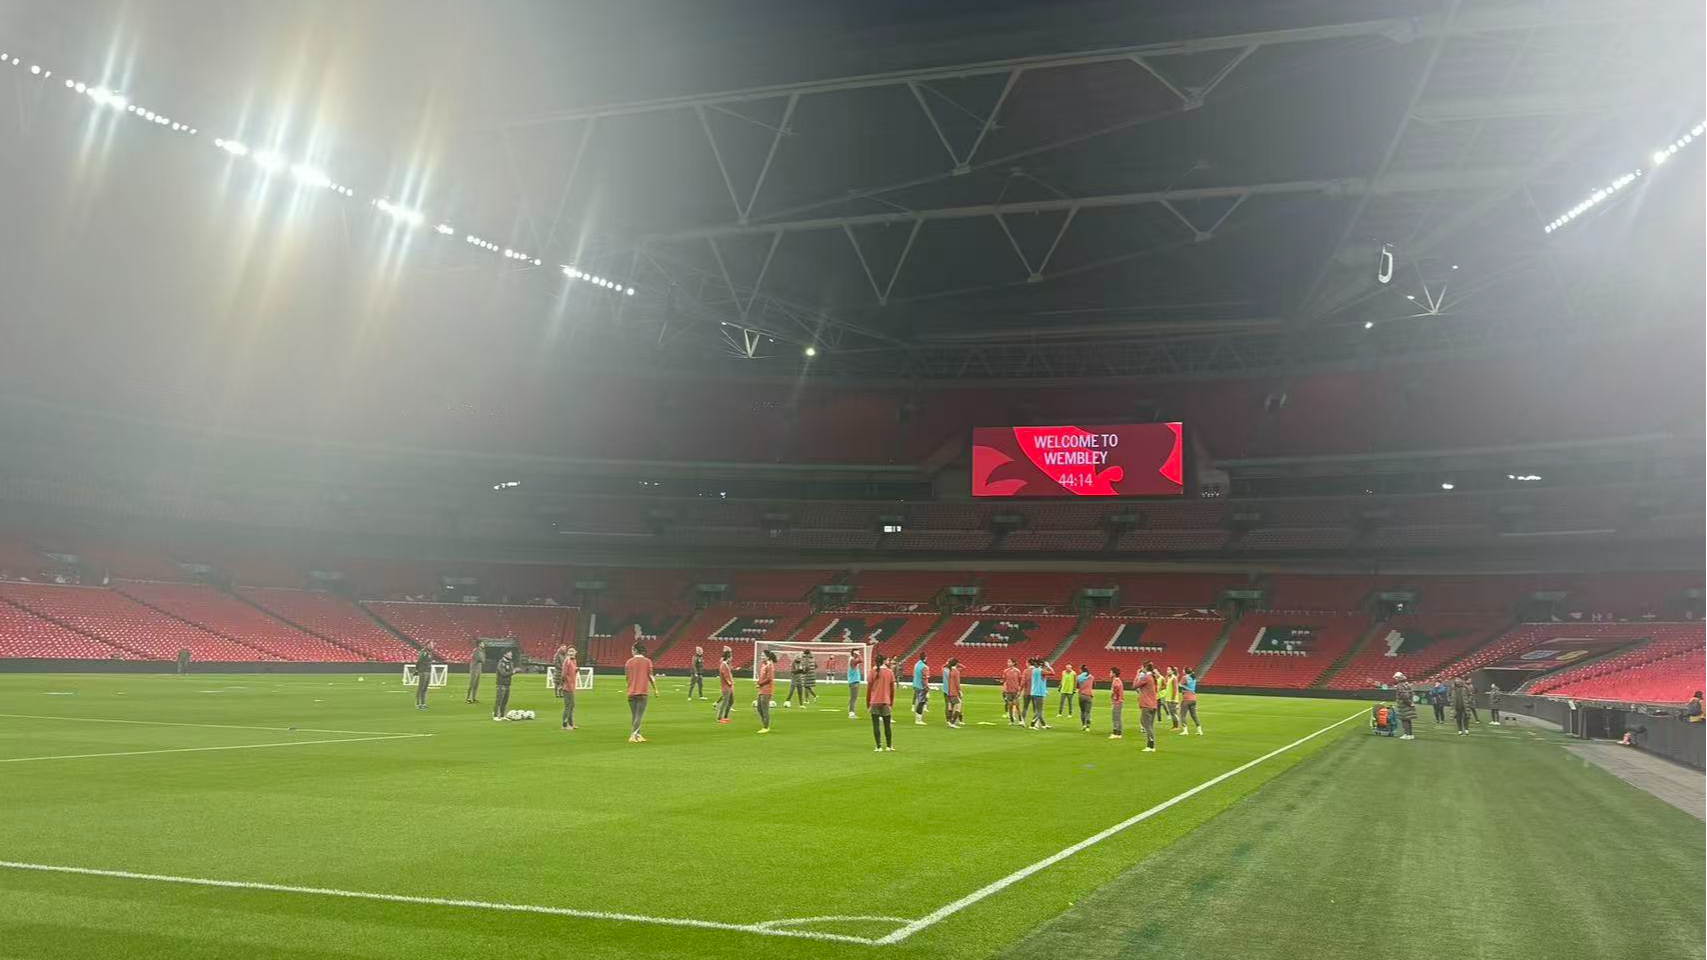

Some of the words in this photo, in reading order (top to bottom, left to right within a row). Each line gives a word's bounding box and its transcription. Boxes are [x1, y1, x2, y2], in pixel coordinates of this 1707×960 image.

[1034, 435, 1099, 448] WELCOME
[1101, 434, 1118, 447] TO
[1044, 451, 1108, 465] WEMBLEY
[1058, 473, 1093, 487] 44:14
